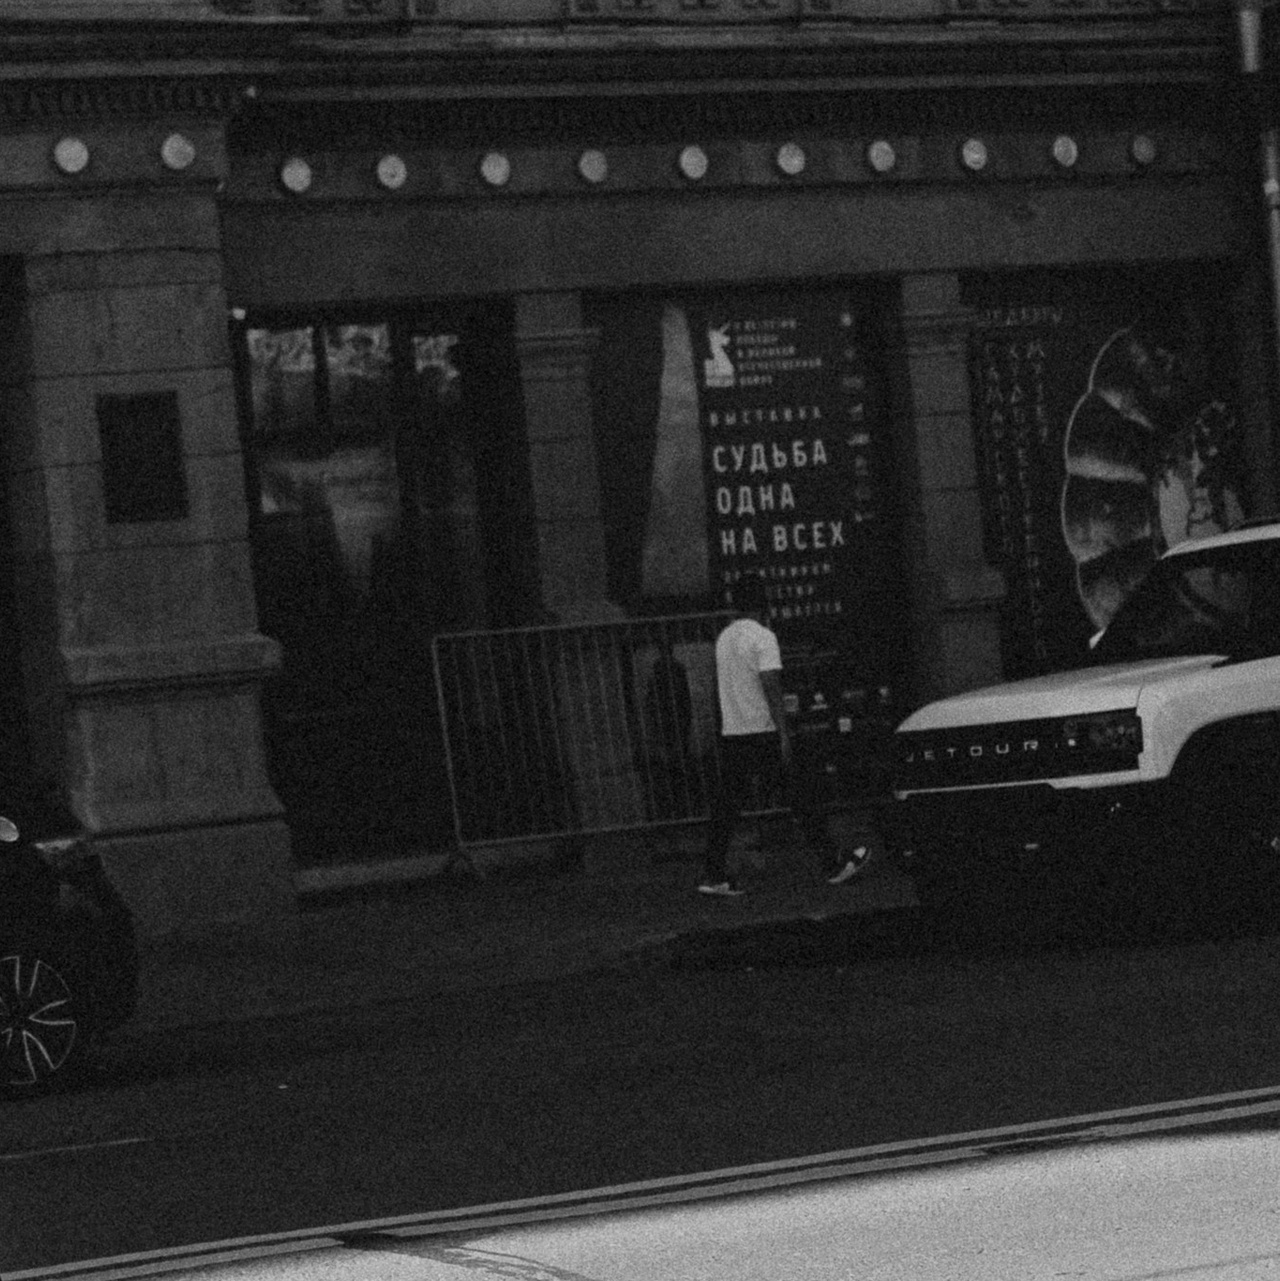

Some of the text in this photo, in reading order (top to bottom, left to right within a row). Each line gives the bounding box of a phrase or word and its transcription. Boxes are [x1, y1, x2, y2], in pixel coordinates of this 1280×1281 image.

[709, 406, 821, 426] ВЫСТАВКА
[712, 439, 827, 473] СУДЬБА
[716, 482, 795, 517] ОДНА
[720, 521, 845, 555] НА ВСЕХ
[905, 740, 1039, 763] JETOUR
